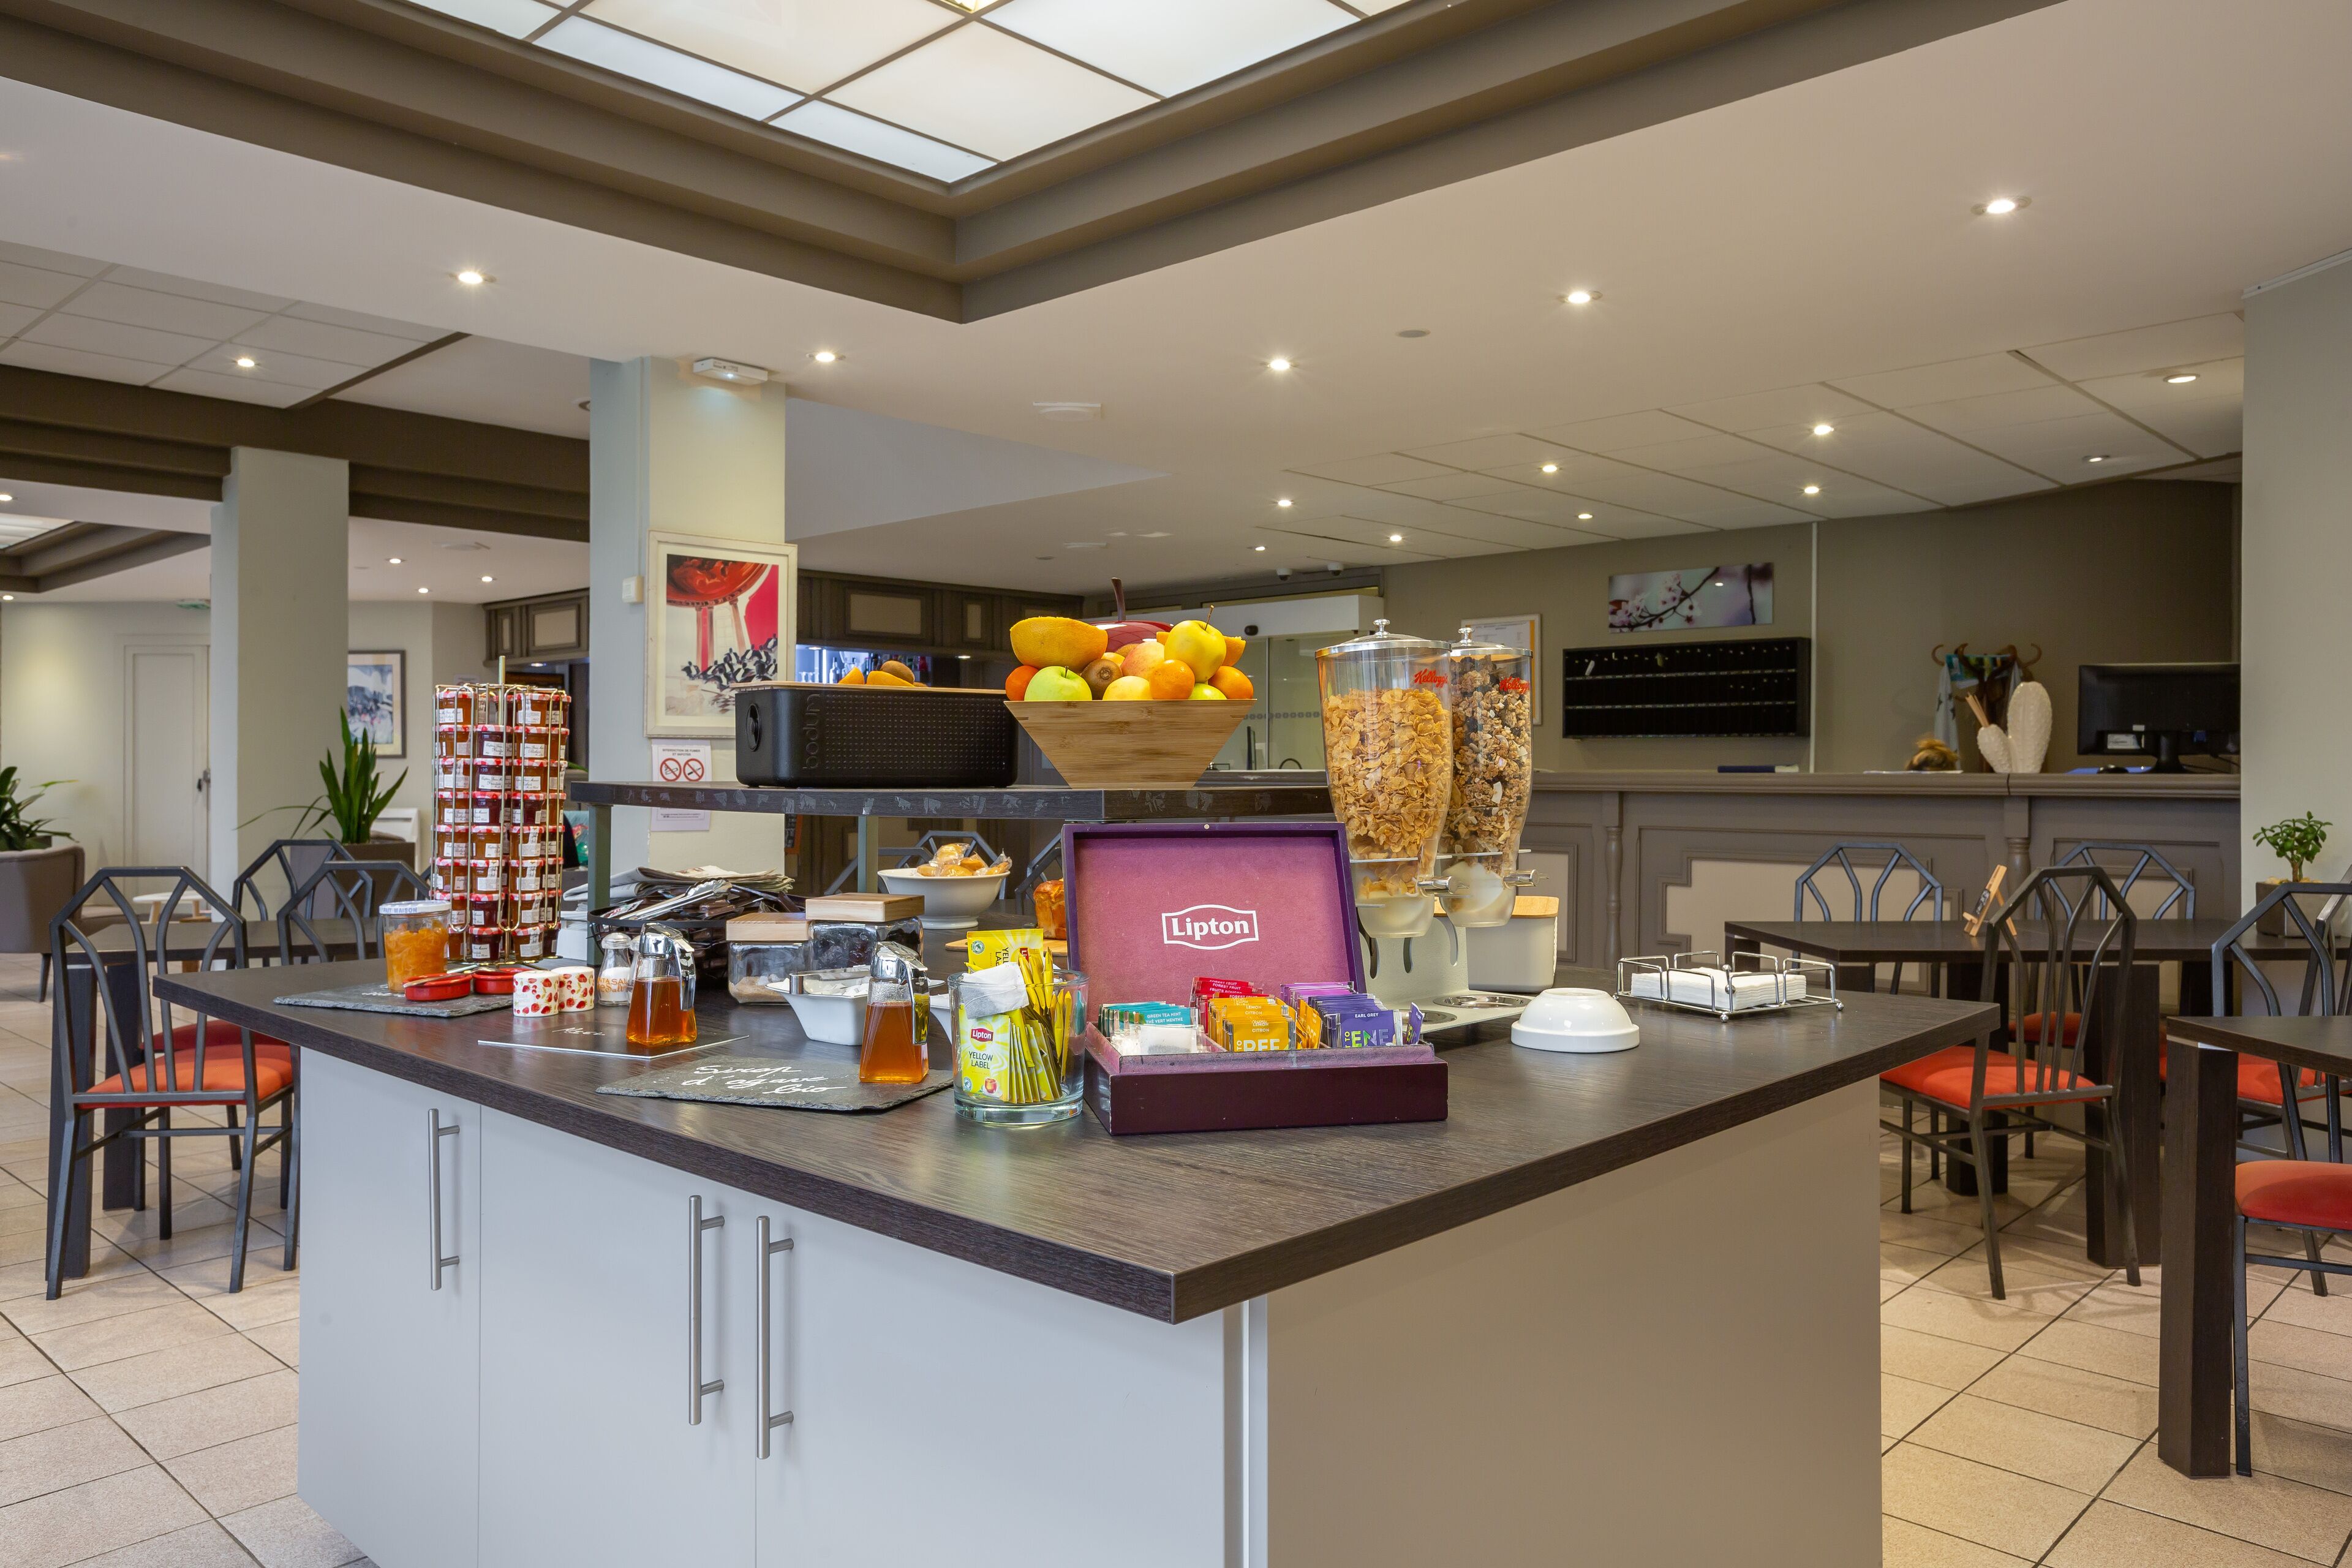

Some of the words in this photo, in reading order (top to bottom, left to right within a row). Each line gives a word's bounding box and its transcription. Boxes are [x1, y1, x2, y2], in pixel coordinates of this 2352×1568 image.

[1414, 668, 1447, 688] Kellogg's
[1172, 918, 1250, 941] Lipton
[972, 1029, 992, 1040] Lipton
[969, 1052, 993, 1061] YELLOW
[971, 1060, 990, 1069] LABEL
